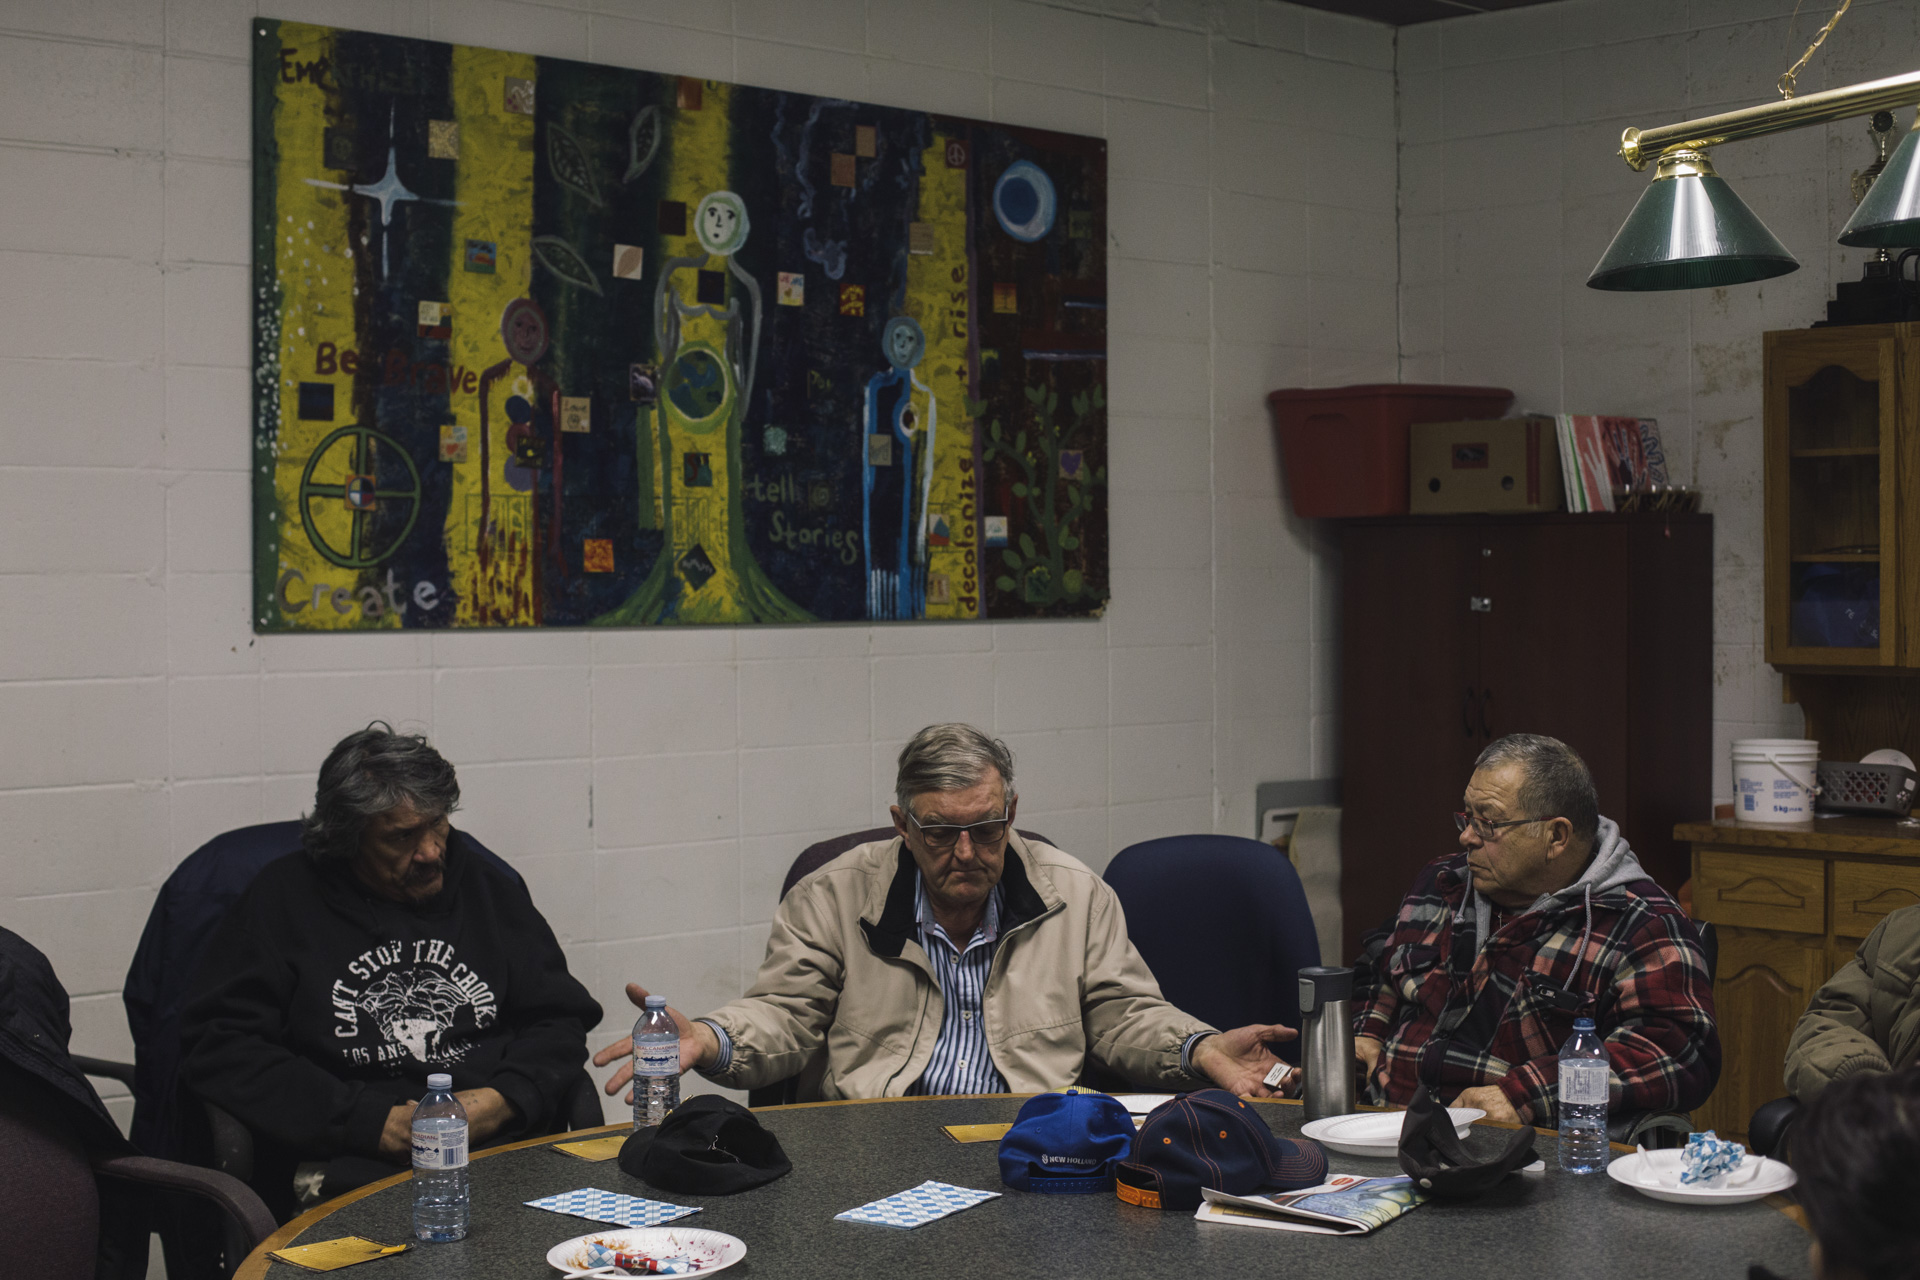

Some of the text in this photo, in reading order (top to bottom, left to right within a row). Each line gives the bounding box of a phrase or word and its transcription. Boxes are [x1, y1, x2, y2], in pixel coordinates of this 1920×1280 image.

[950, 264, 966, 338] rise
[315, 342, 359, 375] Be
[748, 473, 795, 504] tell
[769, 511, 858, 565] Stories
[956, 457, 977, 612] decolonize
[277, 568, 440, 617] Create
[332, 979, 359, 1037] CAN'T
[348, 940, 402, 980] STOP
[413, 939, 455, 970] THE
[1067, 1157, 1096, 1165] HOLLAND
